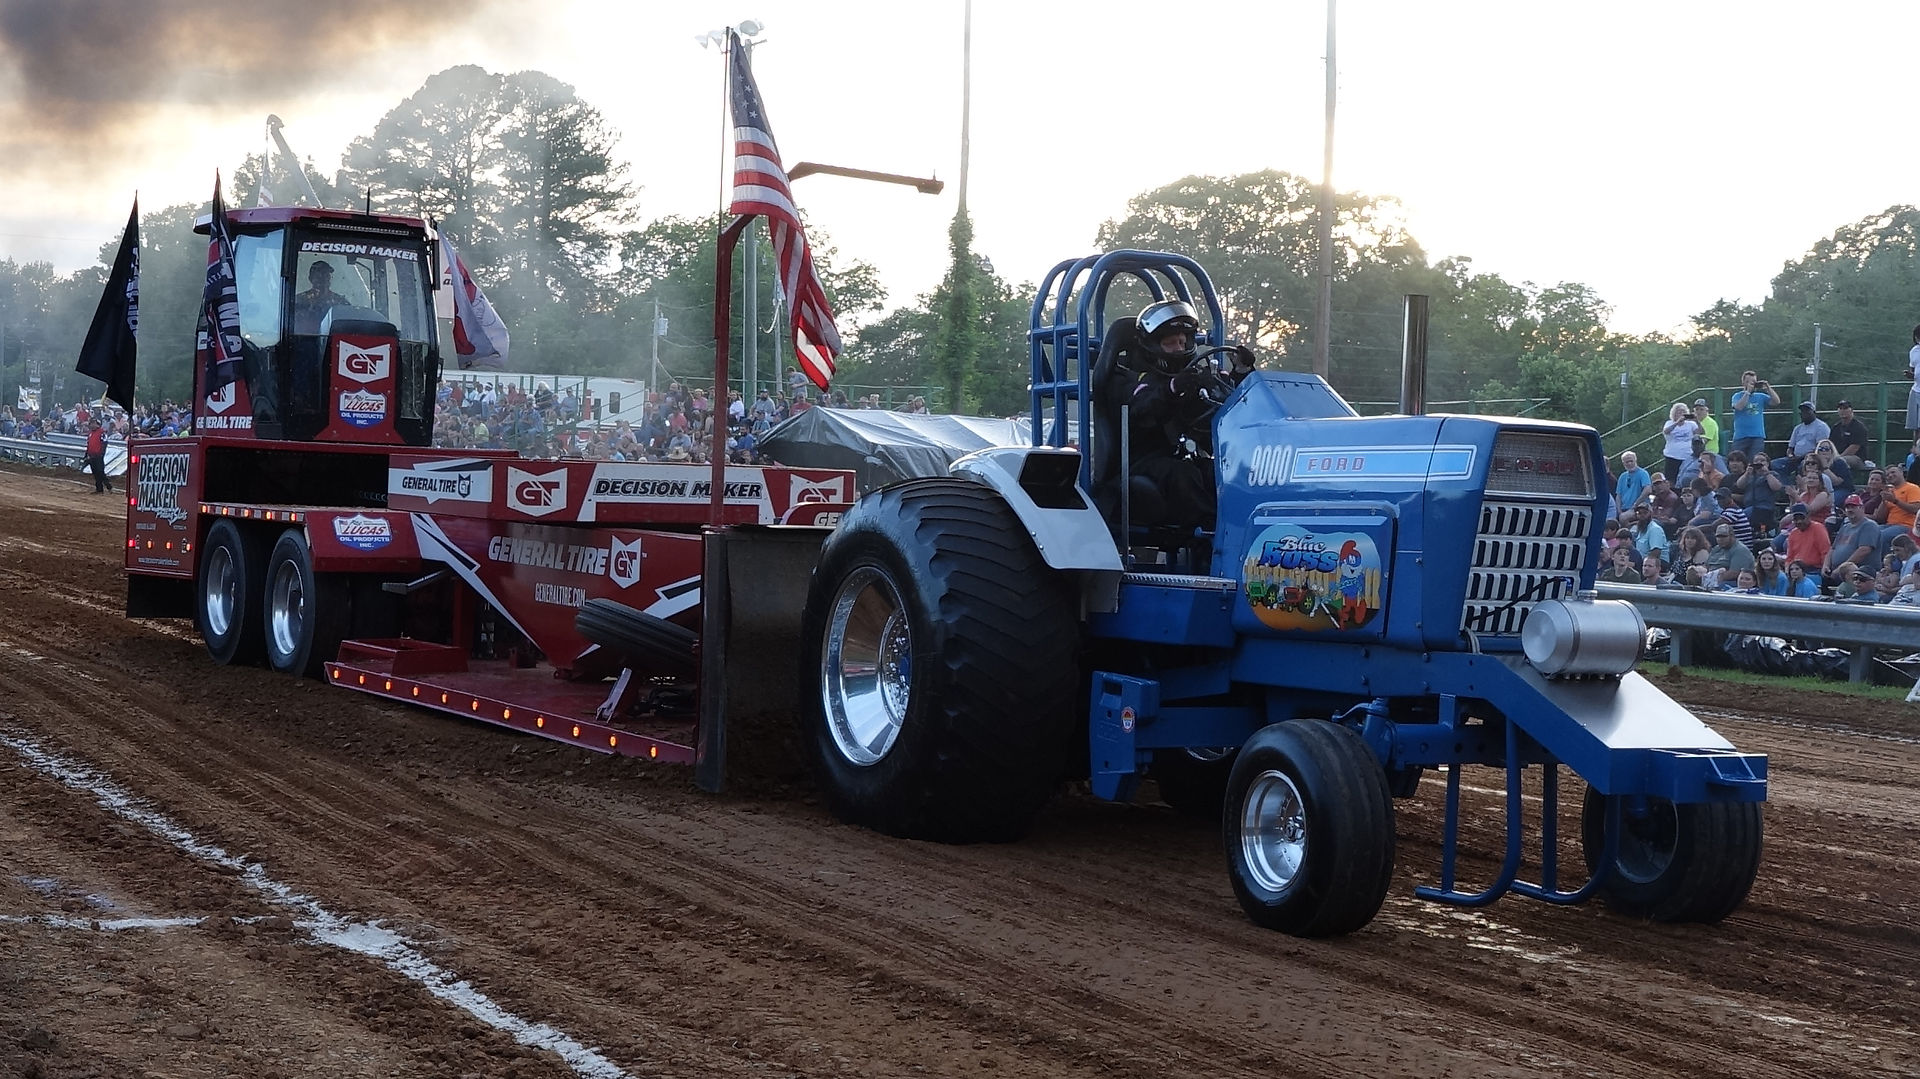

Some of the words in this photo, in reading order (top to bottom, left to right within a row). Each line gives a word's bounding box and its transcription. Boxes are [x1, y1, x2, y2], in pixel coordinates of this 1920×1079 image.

[302, 242, 367, 254] DECISION
[369, 246, 418, 261] MAKER
[345, 353, 384, 375] GT
[344, 399, 384, 412] LUCAS
[229, 416, 253, 429] TIRE
[138, 454, 190, 485] DECISION
[1248, 444, 1292, 487] 9000
[1307, 455, 1365, 472] FORD
[402, 476, 438, 492] GENERAL
[438, 479, 457, 493] TIRE
[515, 481, 560, 507] GT
[593, 478, 689, 497] DECISION
[691, 481, 762, 499] MKER
[137, 483, 178, 511] MAKER
[342, 525, 386, 535] LUCAS
[1279, 534, 1326, 552] Blue
[488, 536, 565, 570] GENERAL
[567, 545, 609, 576] TIRE
[535, 583, 586, 608] GENERALTIRE.COM
